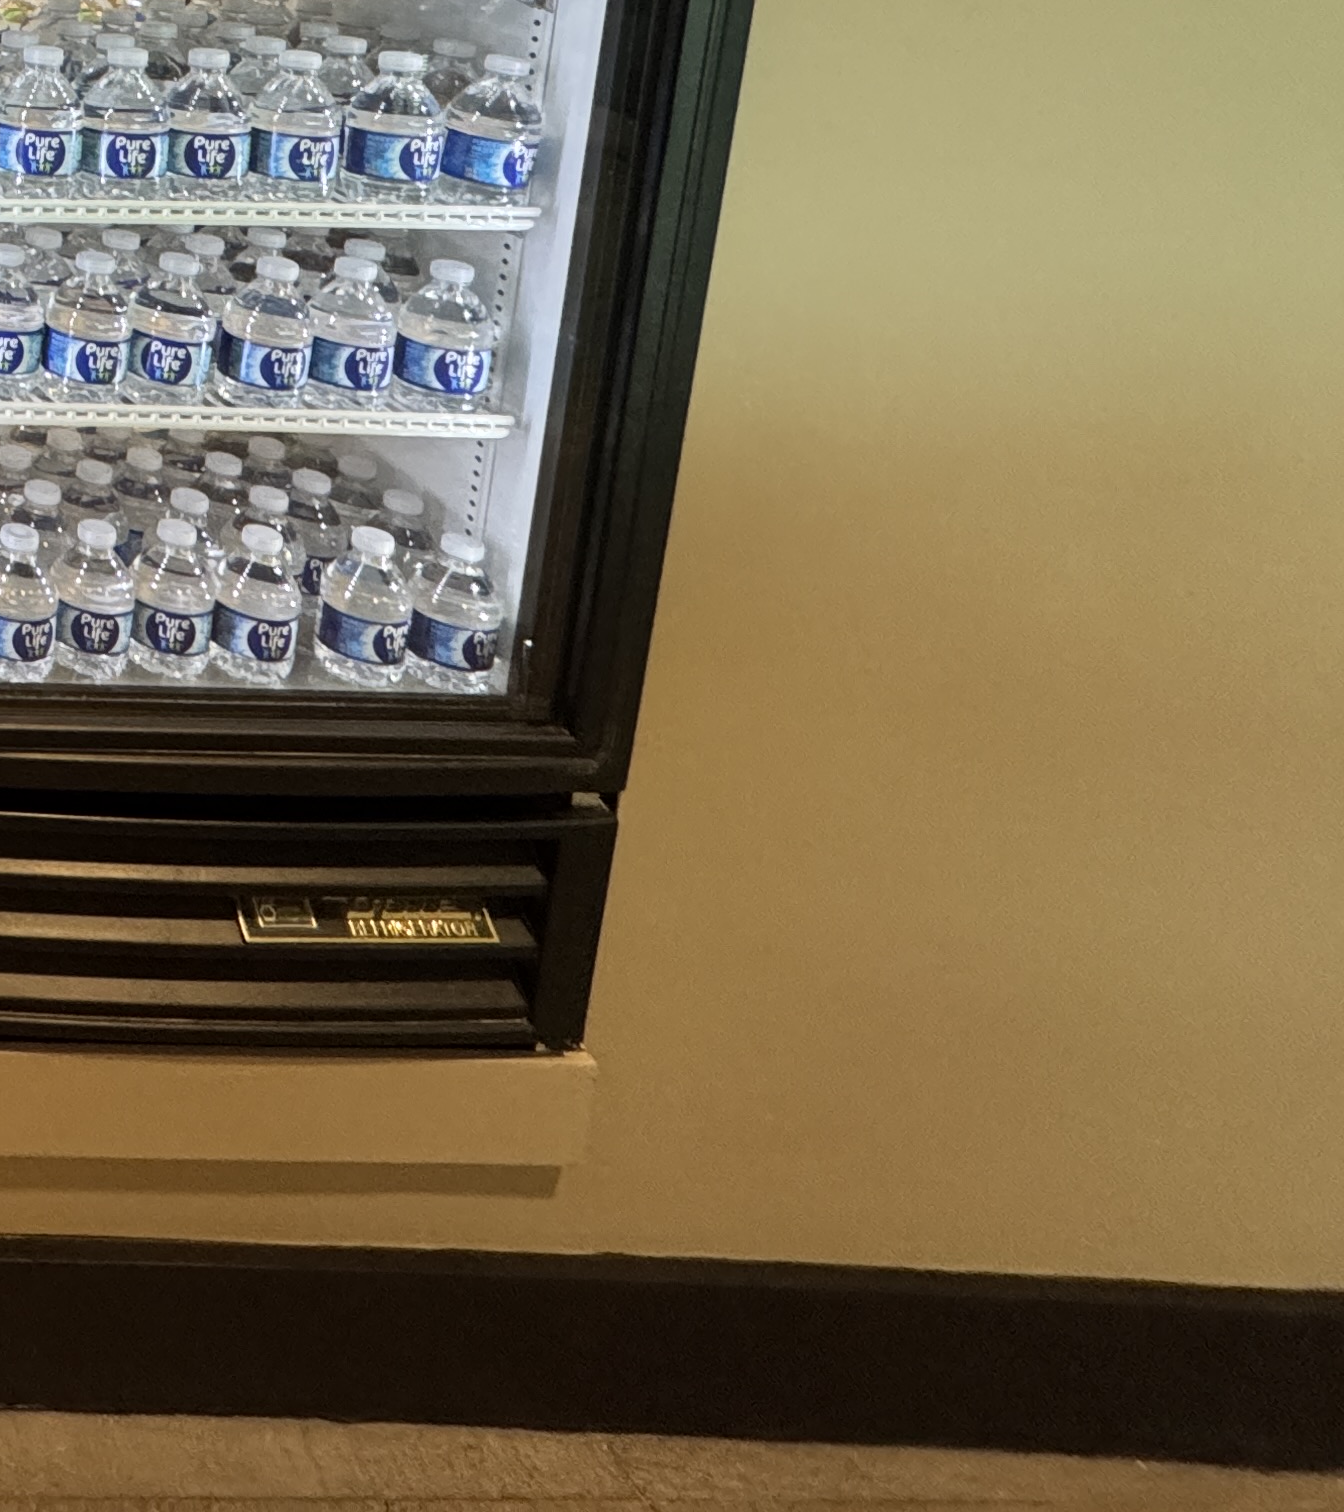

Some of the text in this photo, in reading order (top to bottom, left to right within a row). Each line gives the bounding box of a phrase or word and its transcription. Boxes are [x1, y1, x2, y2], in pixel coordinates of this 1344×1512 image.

[24, 133, 60, 149] Pure
[115, 135, 151, 151] Pure
[193, 135, 230, 152] Pure
[299, 139, 332, 153] Pure
[27, 147, 57, 165] Life
[118, 149, 148, 166] Life
[197, 149, 228, 167] Life
[301, 152, 330, 169] Life
[85, 342, 119, 358] Pure
[150, 341, 187, 359] Pure
[271, 348, 303, 363] Pure
[355, 348, 388, 363] Pure
[88, 356, 115, 372] Life
[153, 355, 182, 373] Life
[274, 361, 300, 378] Life
[358, 361, 384, 378] Life
[80, 613, 116, 630] Pure
[154, 612, 191, 630] Pure
[257, 622, 290, 637] Pure
[21, 622, 51, 638] Pure
[83, 627, 112, 644] Life
[158, 626, 186, 644] Life
[24, 635, 48, 650] Life
[260, 634, 286, 650] Life
[348, 919, 479, 937] REFRIGERATOR
